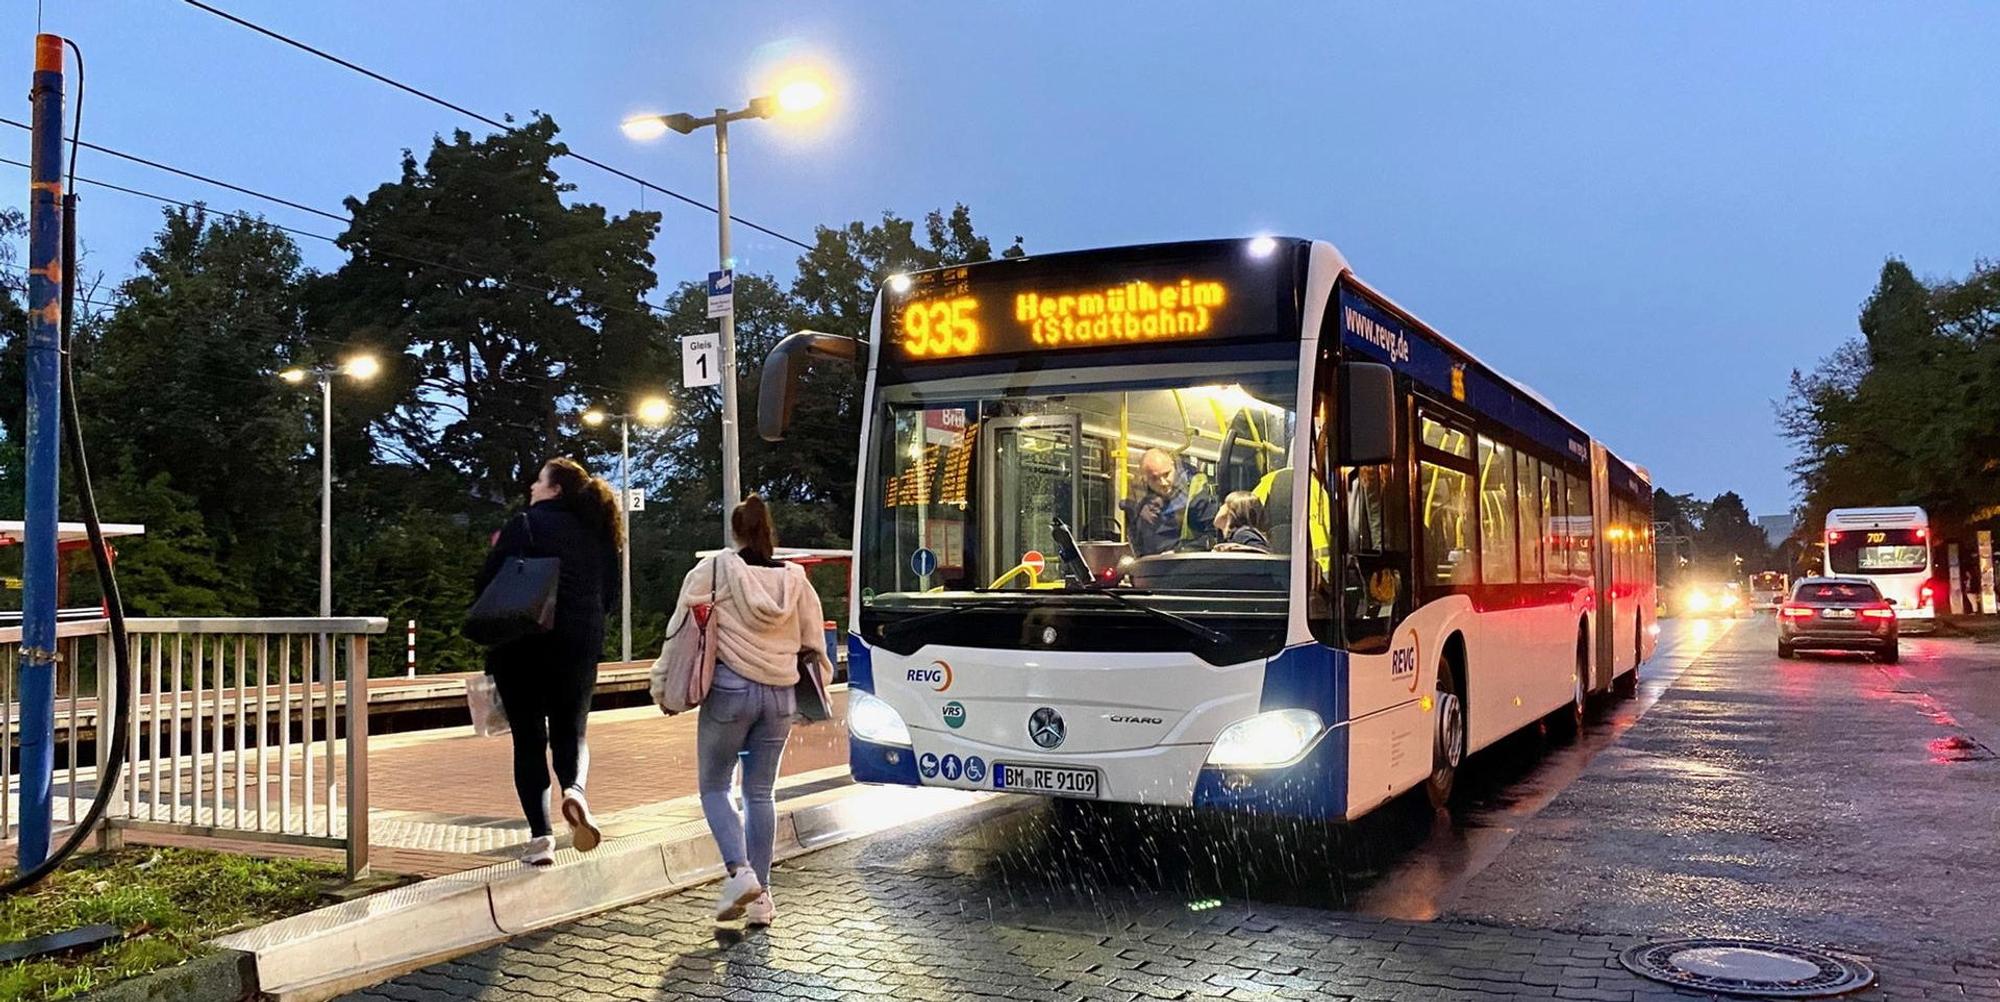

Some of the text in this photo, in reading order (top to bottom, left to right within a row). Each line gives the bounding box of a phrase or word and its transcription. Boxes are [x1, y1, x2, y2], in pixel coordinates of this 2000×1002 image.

[1016, 280, 1225, 321] Hermülheim
[904, 297, 979, 356] 935
[1032, 305, 1209, 344] (Stadtbahn)
[1345, 306, 1409, 362] www.revg.de
[690, 340, 712, 351] Gleis
[696, 353, 707, 379] 1
[633, 496, 640, 508] 2
[1867, 532, 1886, 543] 707
[1392, 647, 1414, 674] REVG
[907, 669, 942, 684] REVG
[942, 705, 961, 717] VRS
[1110, 715, 1163, 724] CITARO
[1005, 769, 1095, 792] BM RE 9109
